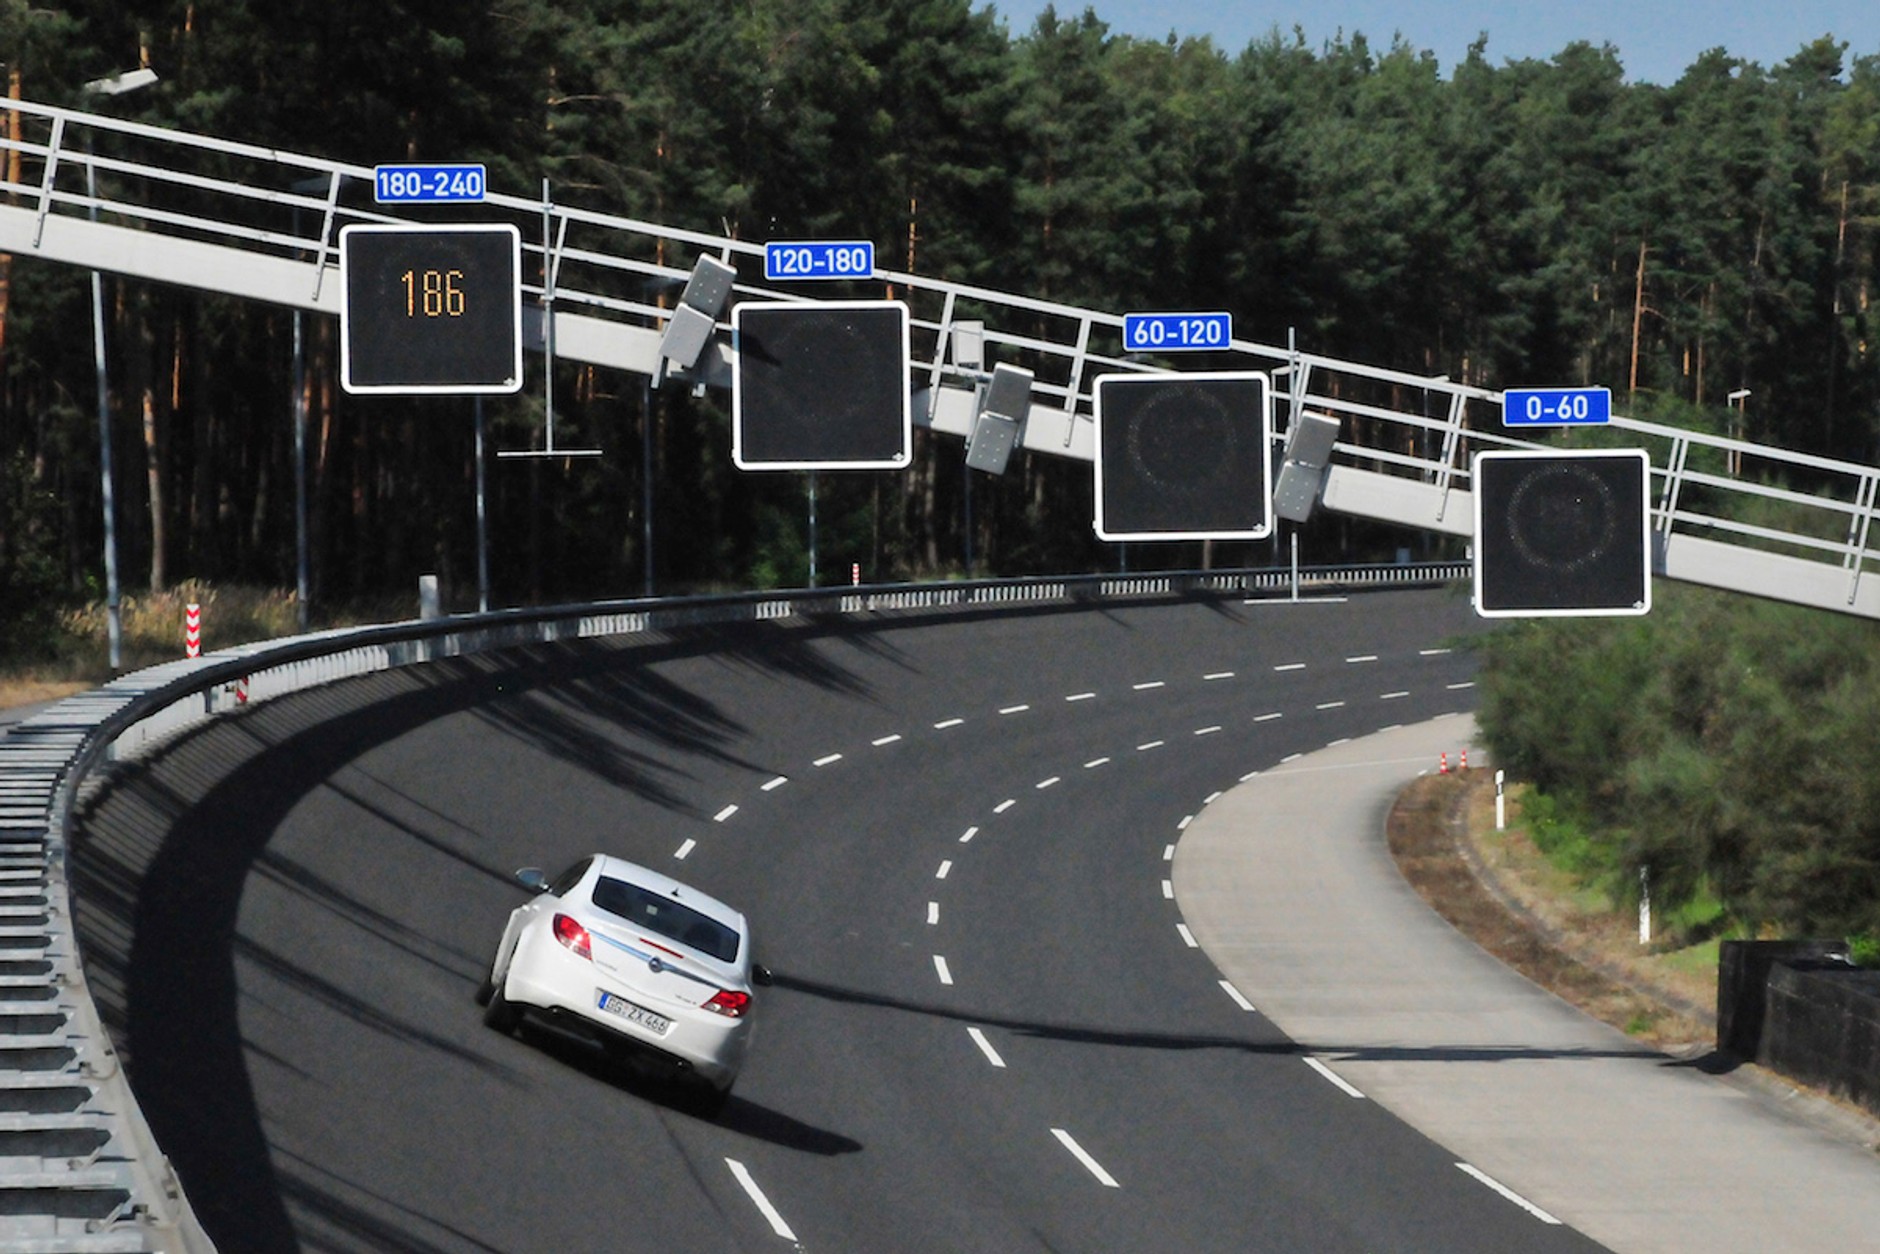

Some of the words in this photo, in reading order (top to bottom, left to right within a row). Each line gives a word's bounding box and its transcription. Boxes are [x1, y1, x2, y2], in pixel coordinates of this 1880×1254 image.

[379, 172, 481, 197] 180-240
[772, 248, 866, 273] 120-180
[401, 270, 465, 317] 186
[1134, 320, 1221, 345] 60-120
[1526, 395, 1588, 420] 0-60
[628, 1006, 644, 1023] ZX
